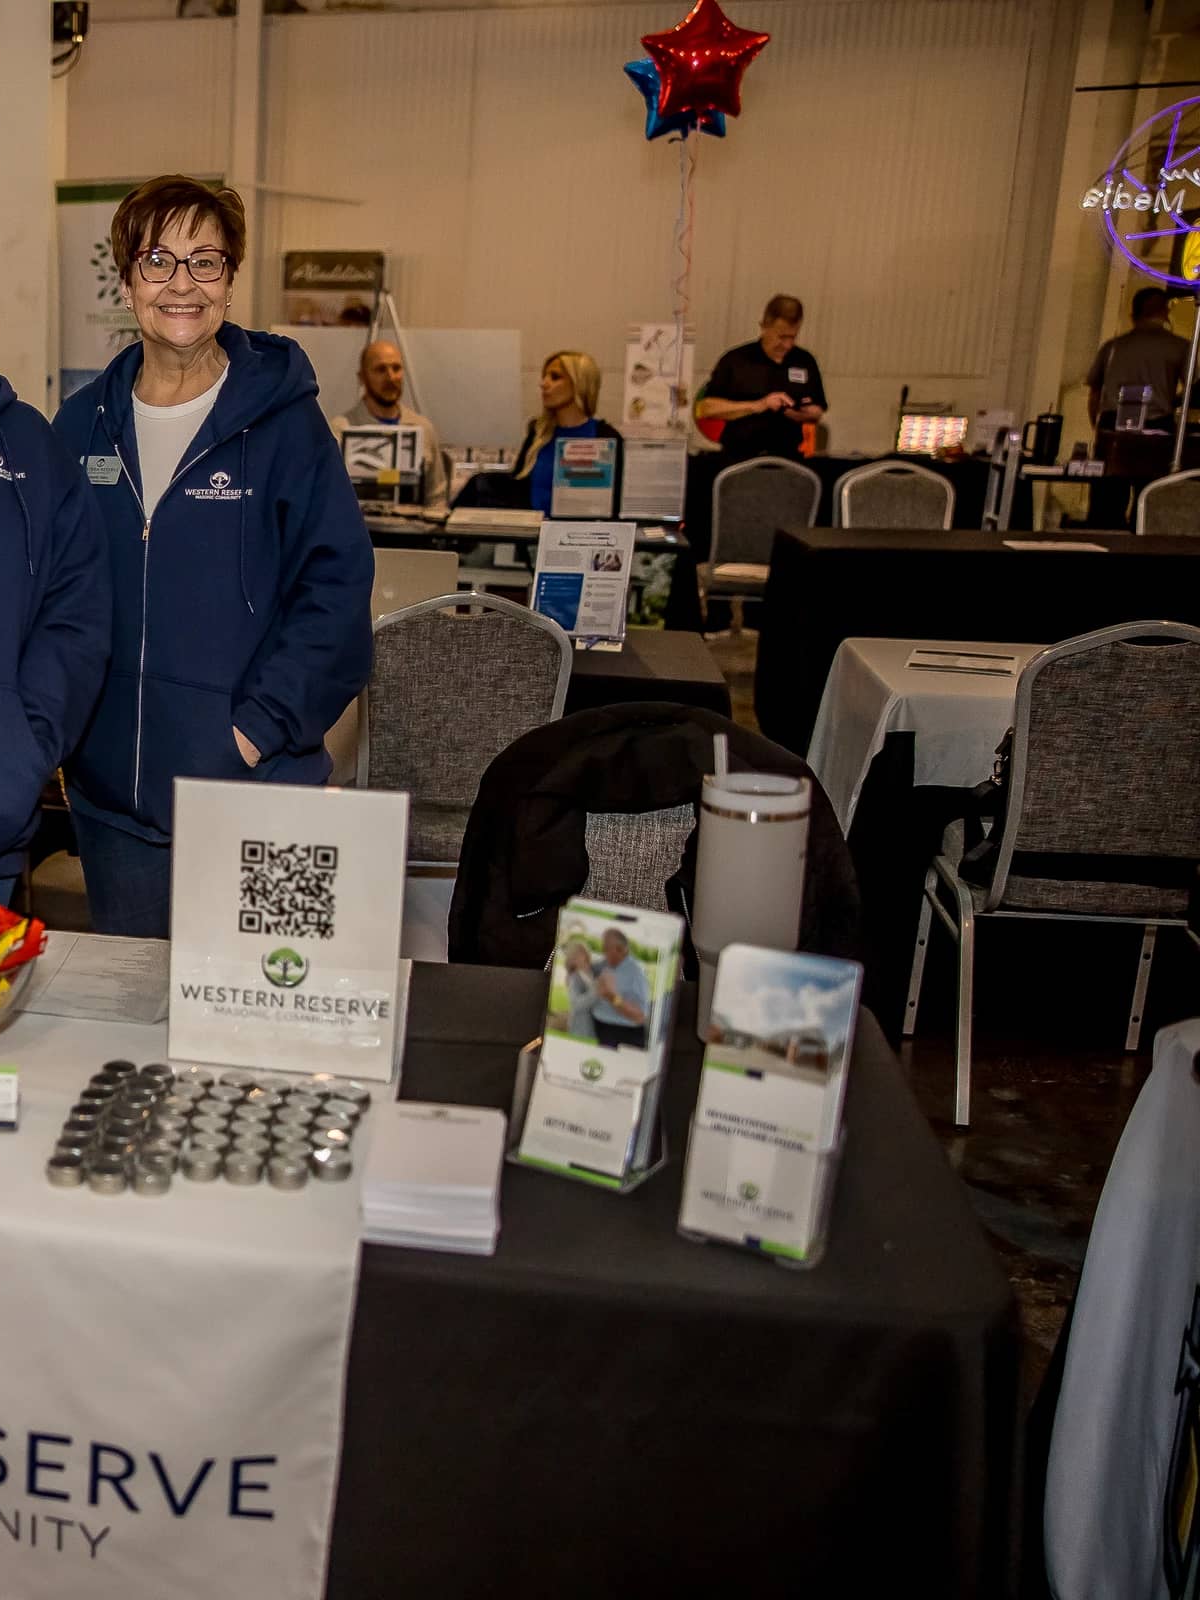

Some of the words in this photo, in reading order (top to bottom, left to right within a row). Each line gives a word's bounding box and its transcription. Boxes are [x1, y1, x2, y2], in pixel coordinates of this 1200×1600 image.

[185, 488, 220, 496] WESTERN
[180, 983, 285, 1009] WESTERN
[293, 993, 390, 1019] RESERVE
